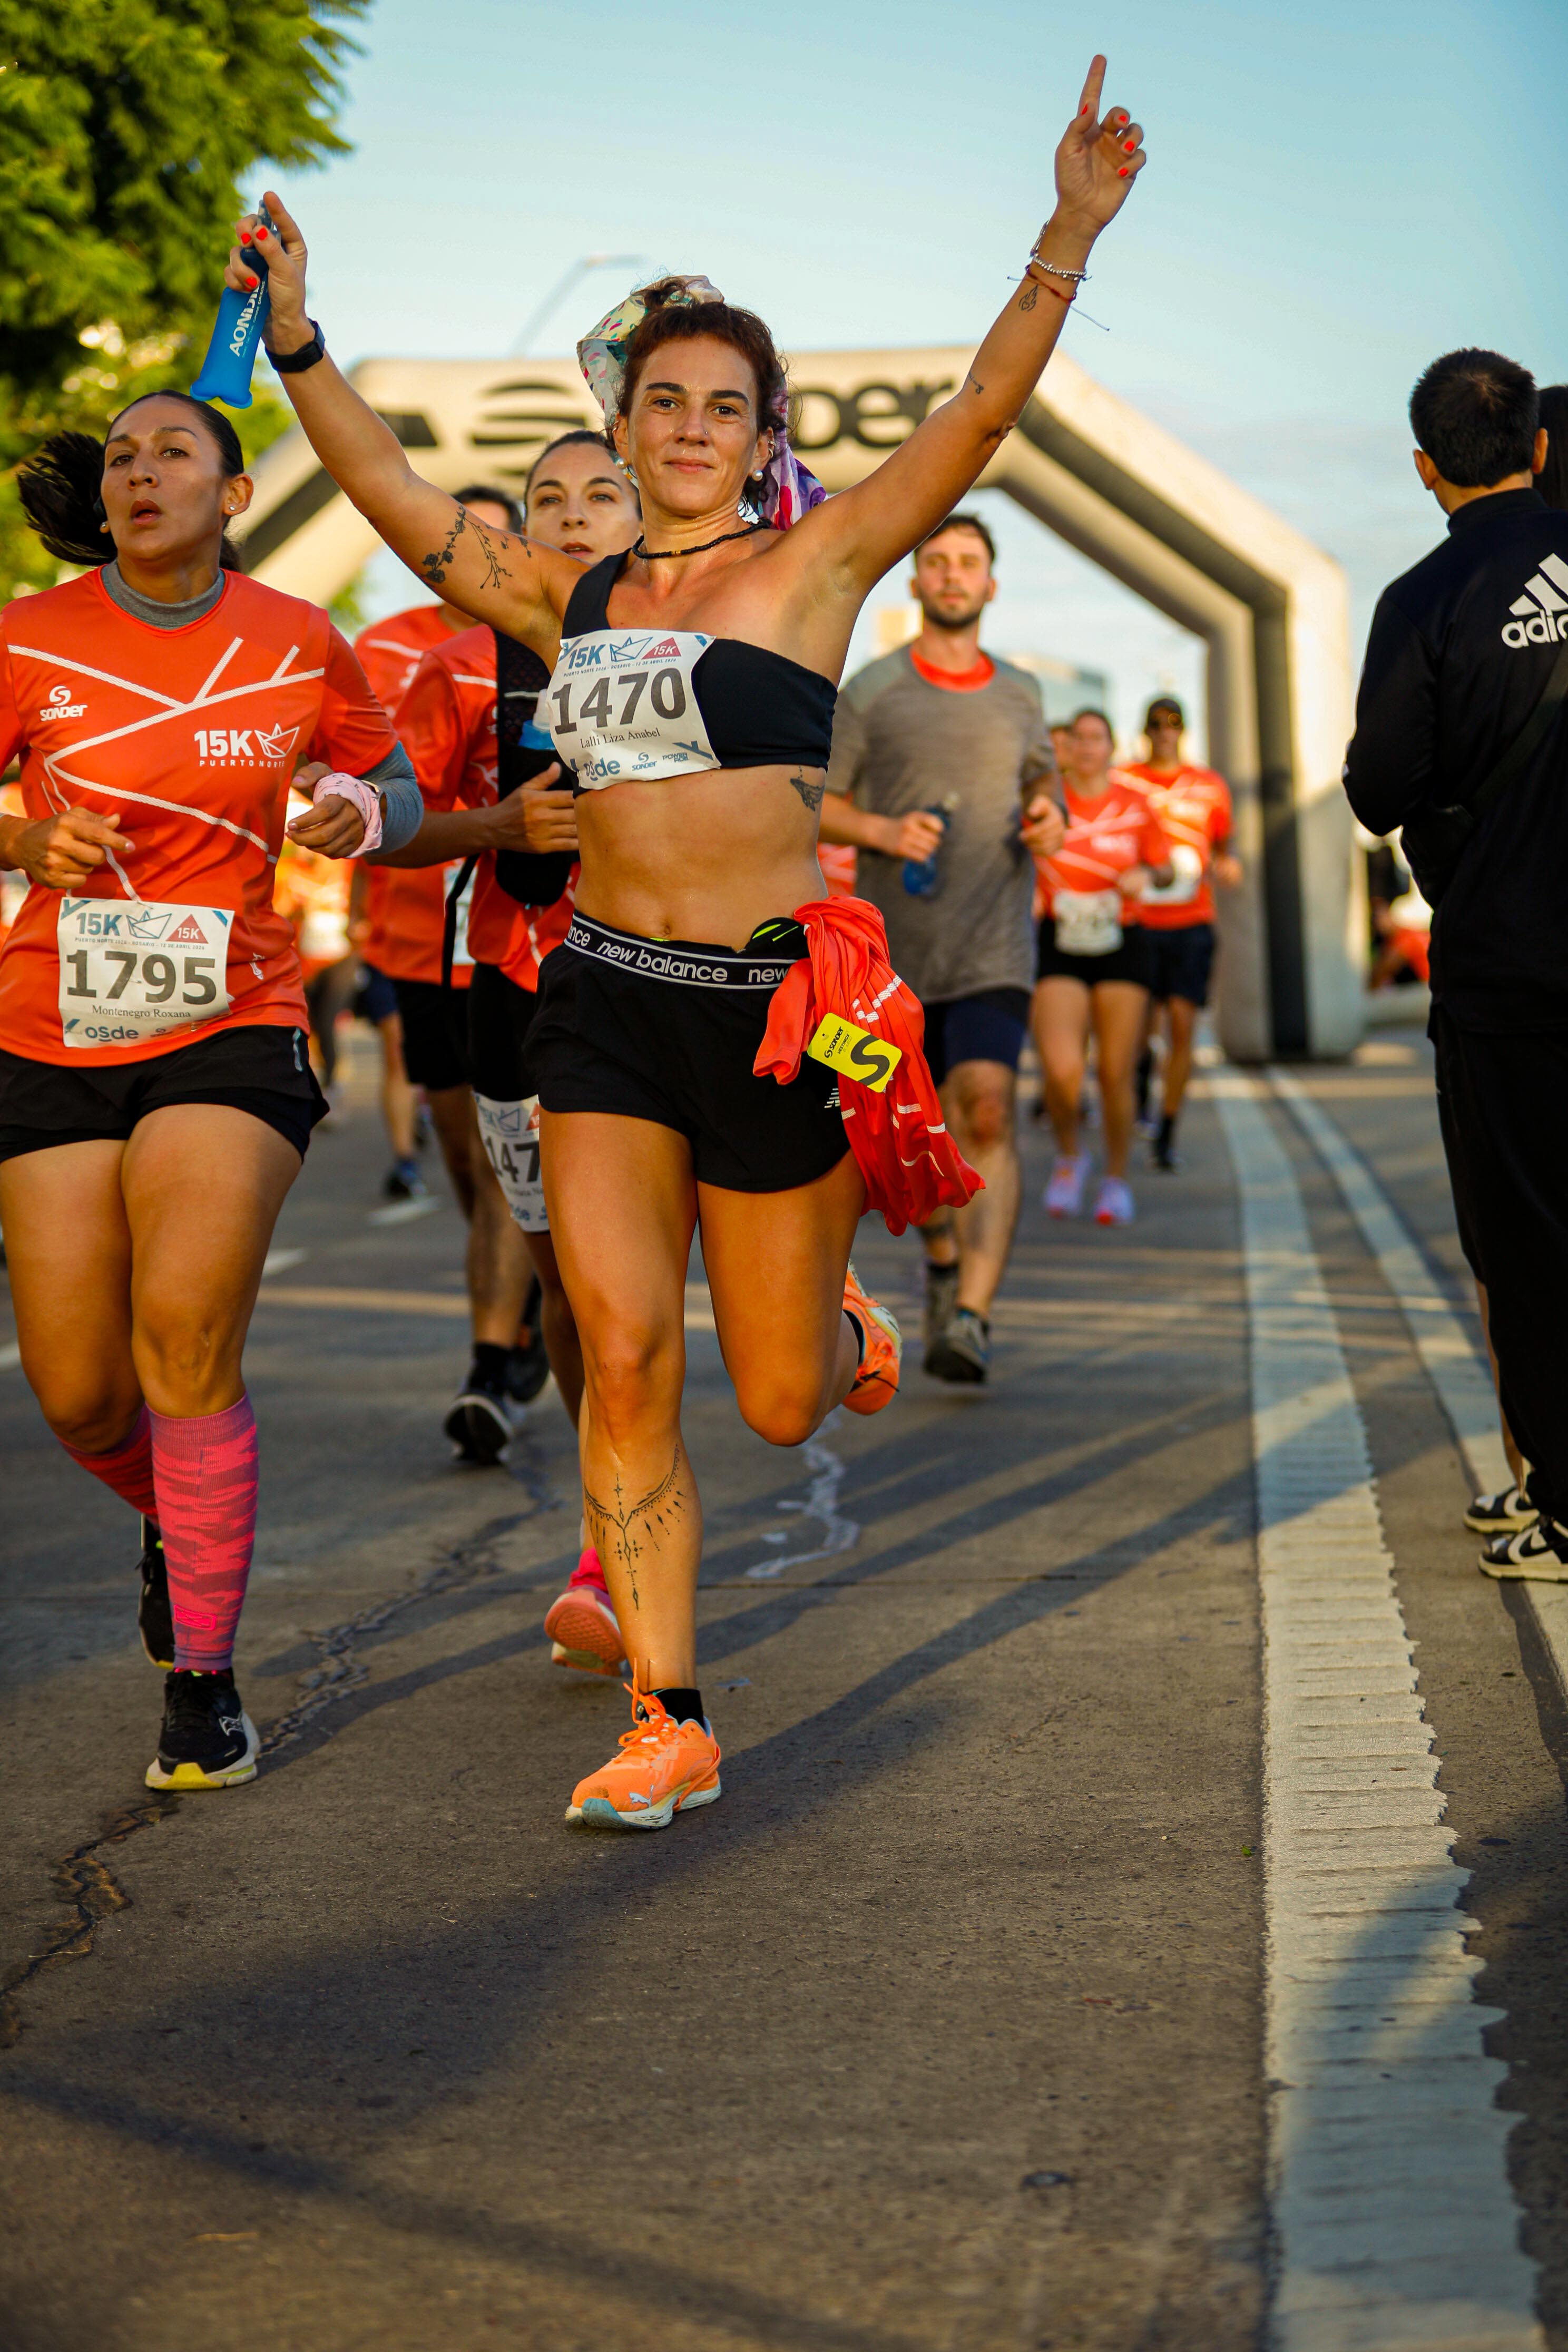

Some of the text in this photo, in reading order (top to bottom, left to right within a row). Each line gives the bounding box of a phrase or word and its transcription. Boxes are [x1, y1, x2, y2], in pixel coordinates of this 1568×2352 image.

[568, 644, 606, 669] 15K
[653, 645, 677, 655] 15K
[552, 668, 686, 735] 1470
[194, 730, 254, 757] 15K
[580, 728, 661, 749] Lalli Liza Anabel
[76, 912, 122, 936] 15K
[177, 927, 199, 939] 15K
[596, 940, 636, 963] new
[635, 948, 728, 982] balance
[66, 949, 217, 1005] 1795
[92, 1005, 191, 1018] Montenegro Roxana
[85, 1025, 139, 1041] osde
